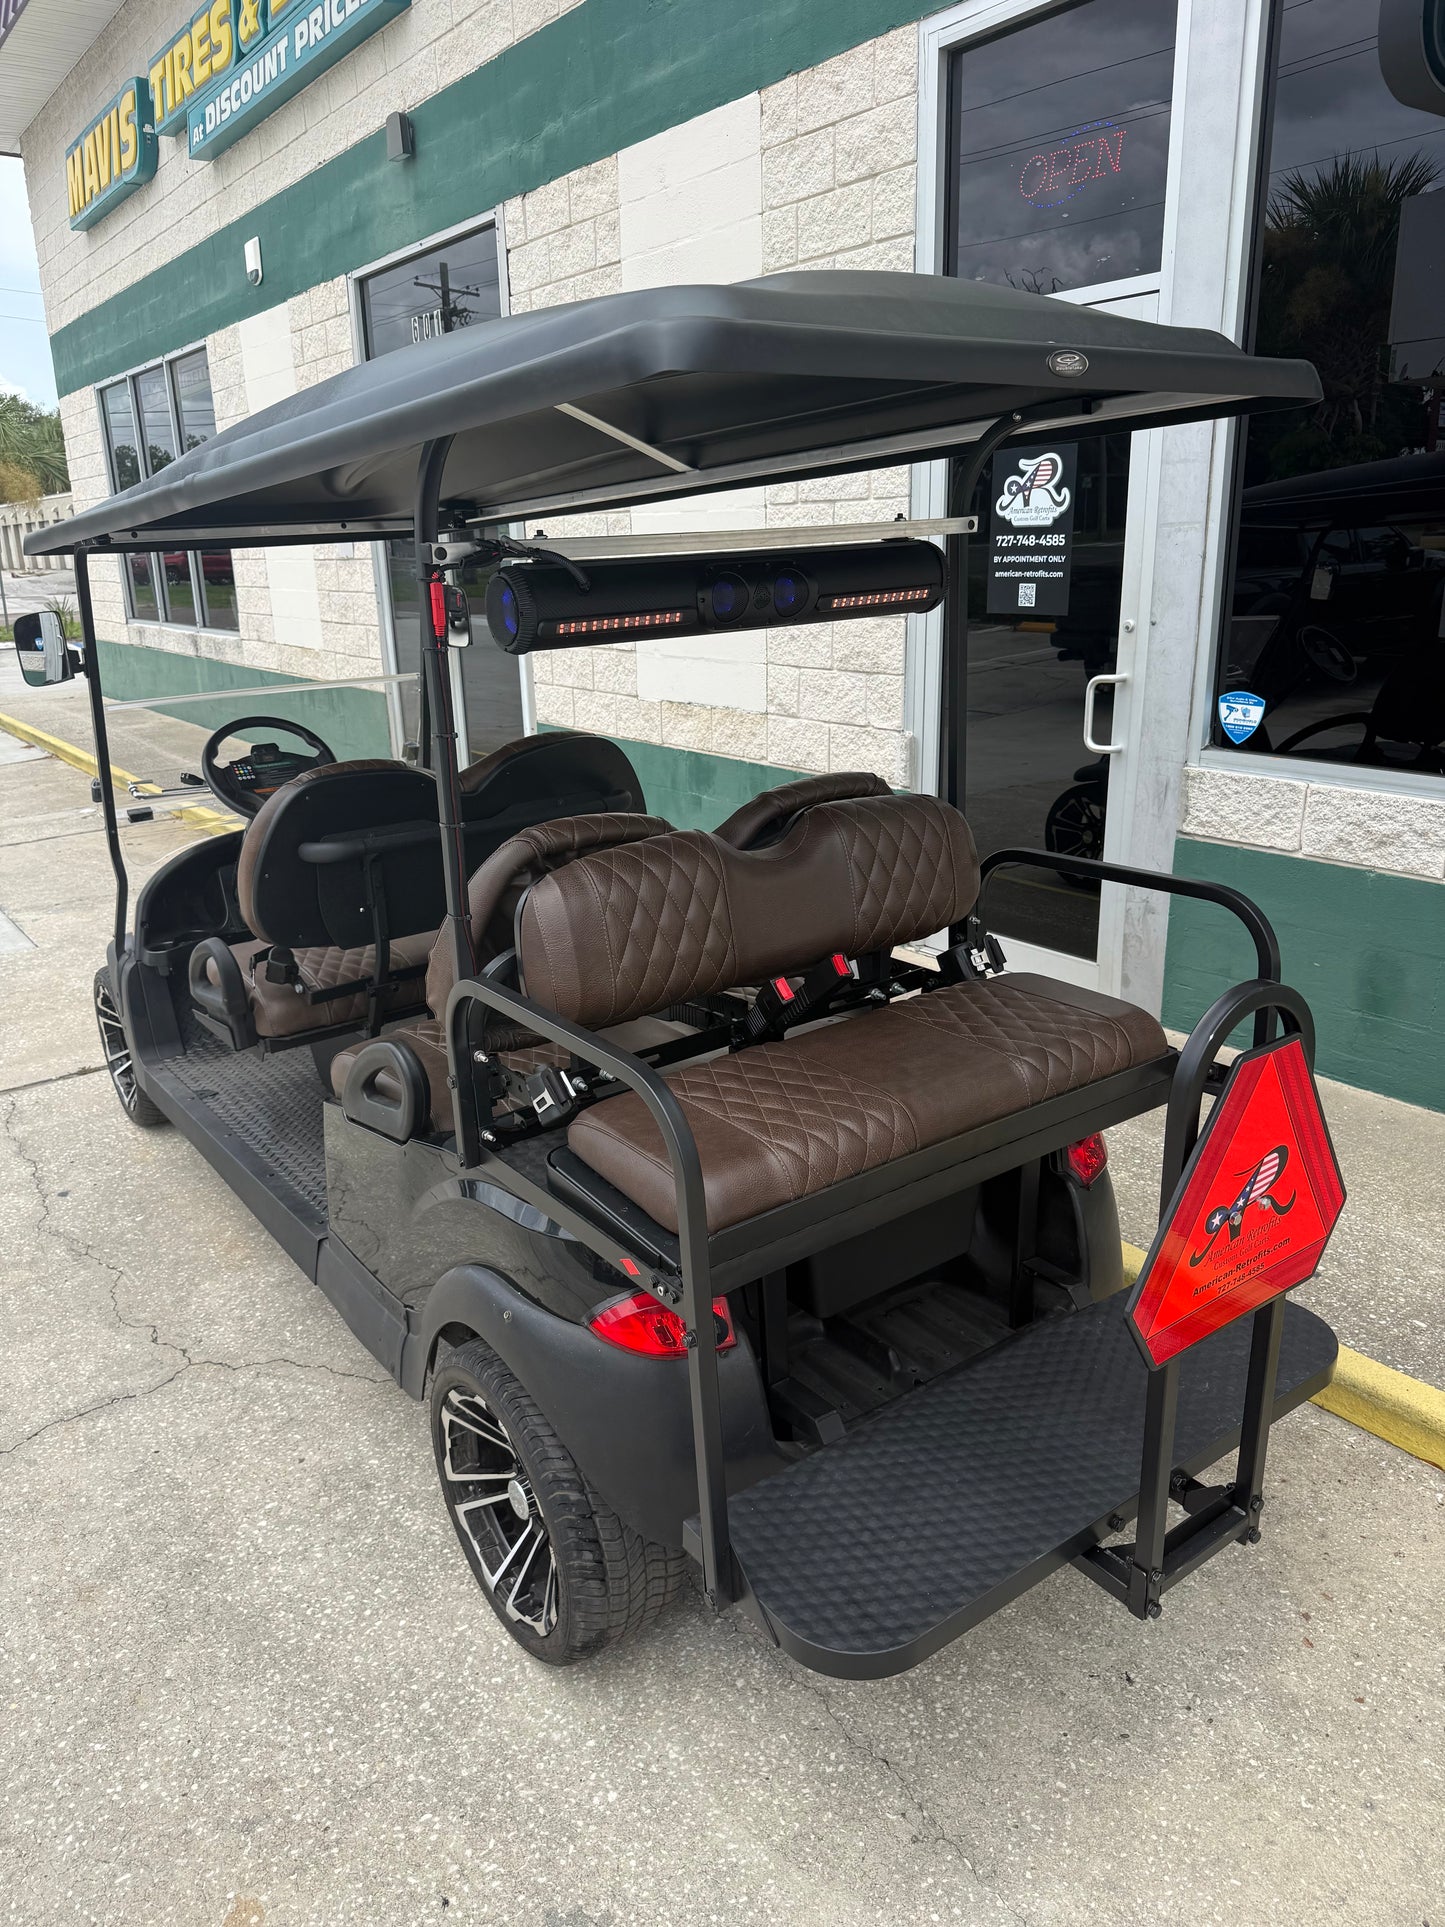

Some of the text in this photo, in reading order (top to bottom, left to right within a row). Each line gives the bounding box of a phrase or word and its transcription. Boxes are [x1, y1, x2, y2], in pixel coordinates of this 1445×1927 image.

[150, 0, 232, 123] TIRES
[193, 0, 369, 146] At DISCOUNT PRIC
[66, 89, 136, 217] MAVIS
[1019, 130, 1127, 198] OPEN
[996, 534, 1066, 547] 727-748-4585
[1003, 555, 1047, 563] APPOINTMENT
[1048, 555, 1066, 563] ONLY
[995, 569, 1064, 578] american-retrofits.com
[1193, 1237, 1291, 1297] American-Retrofits.com
[1204, 1215, 1282, 1267] American Retrofits
[1213, 1236, 1270, 1271] Custom Golf Carts
[1217, 1262, 1265, 1294] 727-748-4585
